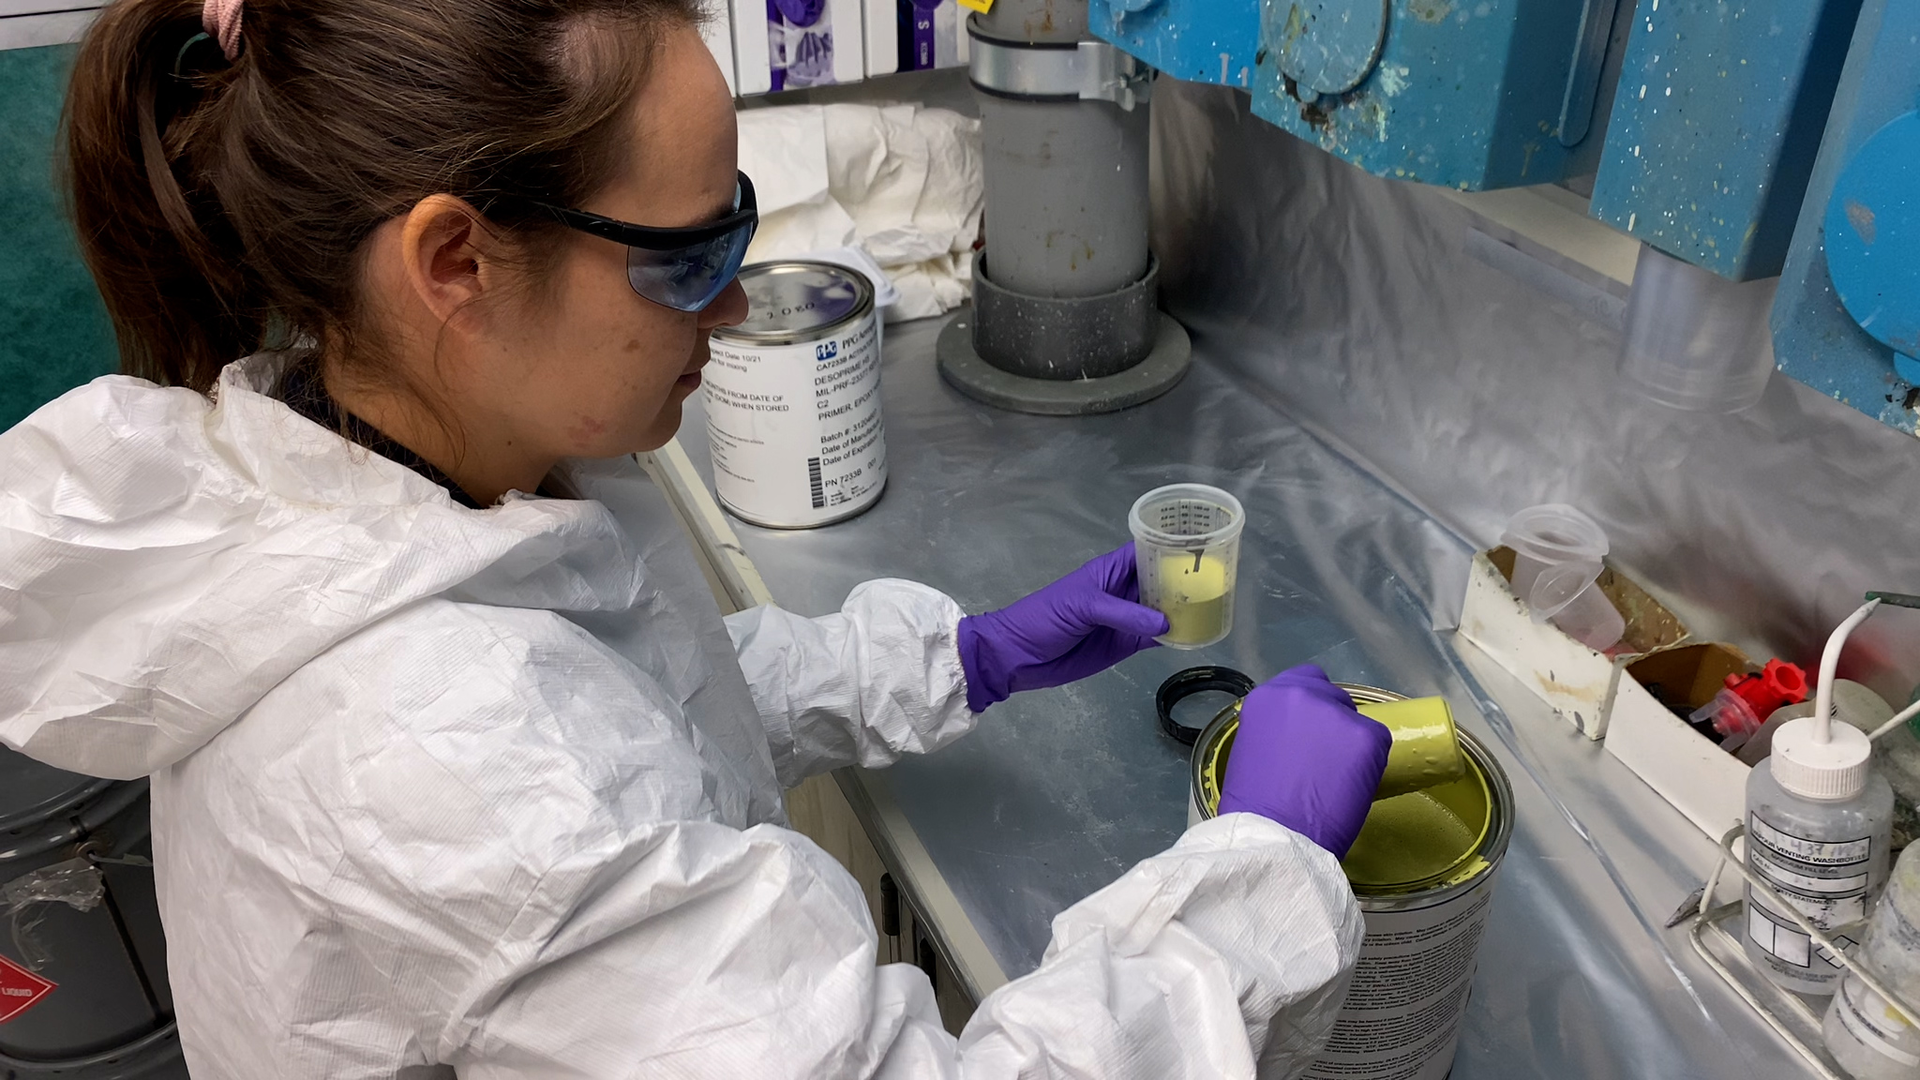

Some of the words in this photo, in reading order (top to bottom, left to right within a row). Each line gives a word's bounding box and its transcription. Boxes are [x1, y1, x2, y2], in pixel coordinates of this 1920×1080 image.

[917, 19, 930, 30] S
[842, 333, 858, 349] PPG
[817, 341, 837, 360] PPG
[814, 363, 861, 386] DESOPRIME
[727, 390, 749, 400] FROM
[749, 394, 770, 402] DATE
[732, 401, 755, 411] WHEN
[755, 404, 790, 412] STORED
[816, 399, 829, 410] C2
[820, 431, 843, 444] Batch
[821, 445, 841, 455] Date
[842, 439, 850, 449] of
[822, 457, 842, 467] Date
[842, 450, 850, 460] of
[824, 477, 838, 488] PN
[1776, 845, 1811, 863] VENTING
[2, 986, 33, 997] LIQUID
